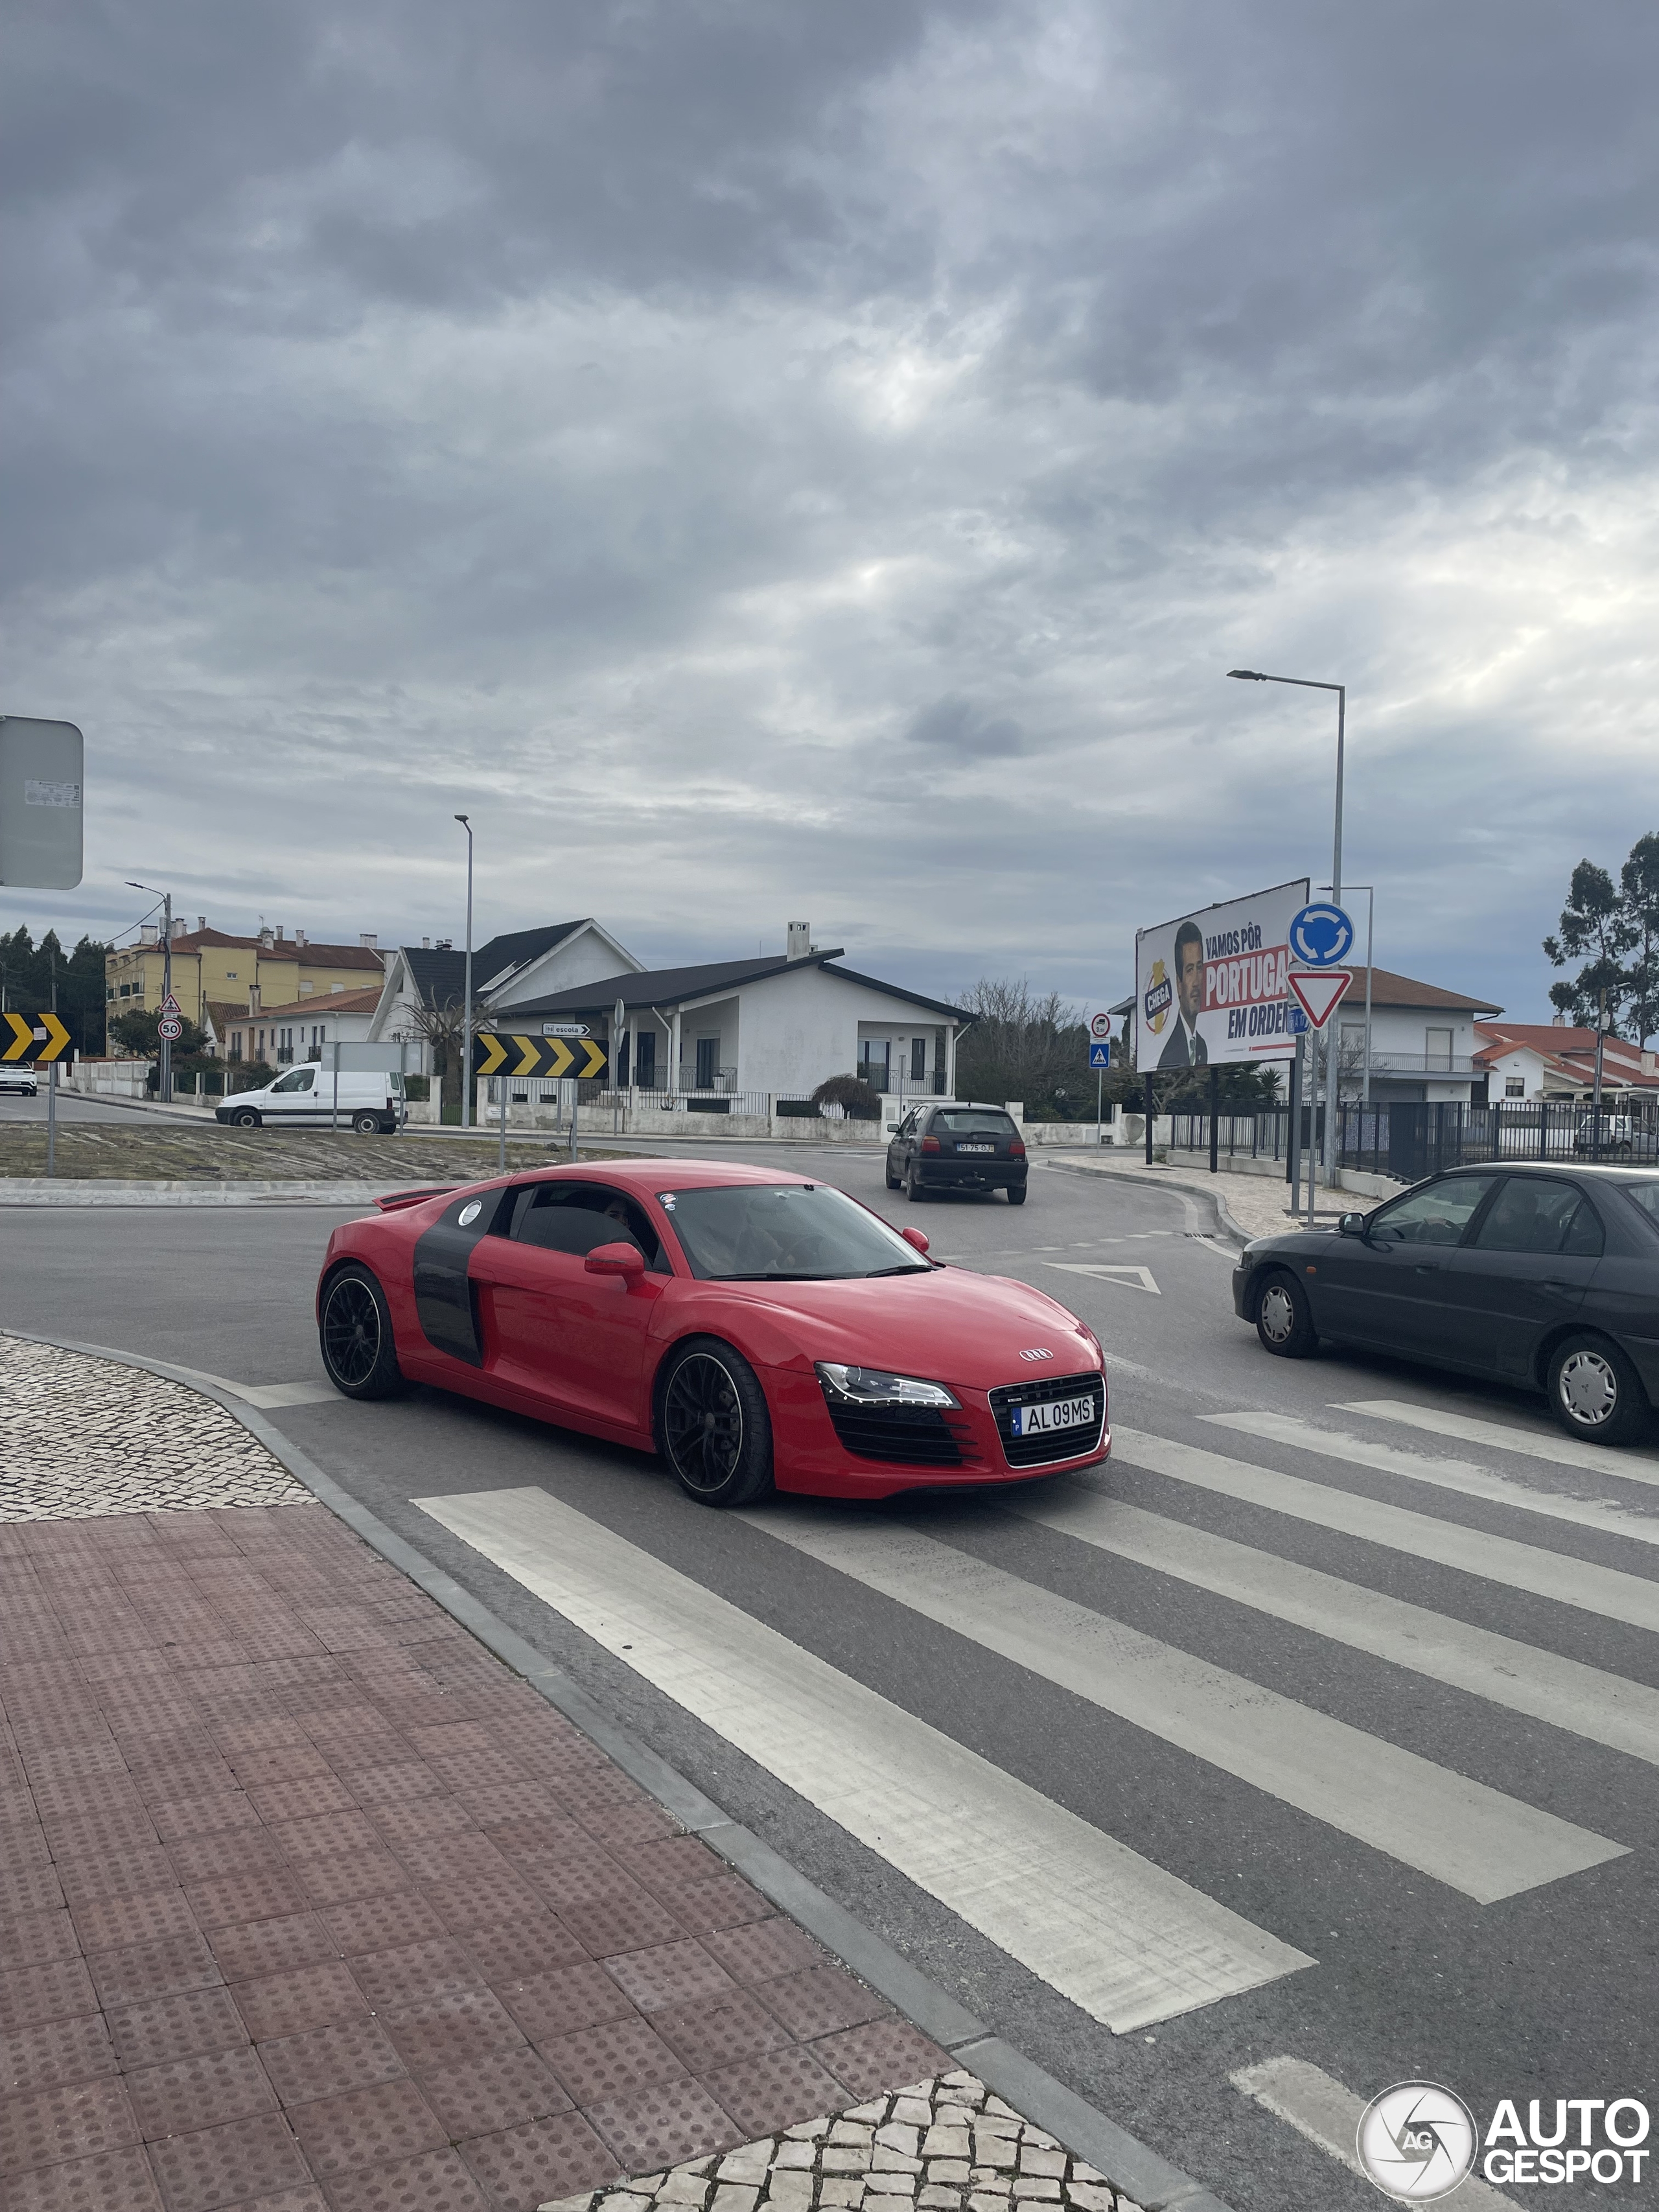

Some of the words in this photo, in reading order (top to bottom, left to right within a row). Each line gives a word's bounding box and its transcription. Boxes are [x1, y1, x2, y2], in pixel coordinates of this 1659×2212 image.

[1206, 930, 1240, 960] VAMOS
[1241, 922, 1262, 952] PÔR
[1148, 984, 1170, 1012] CHEGA
[1228, 1007, 1247, 1039] EM
[1028, 1407, 1050, 1431] AL
